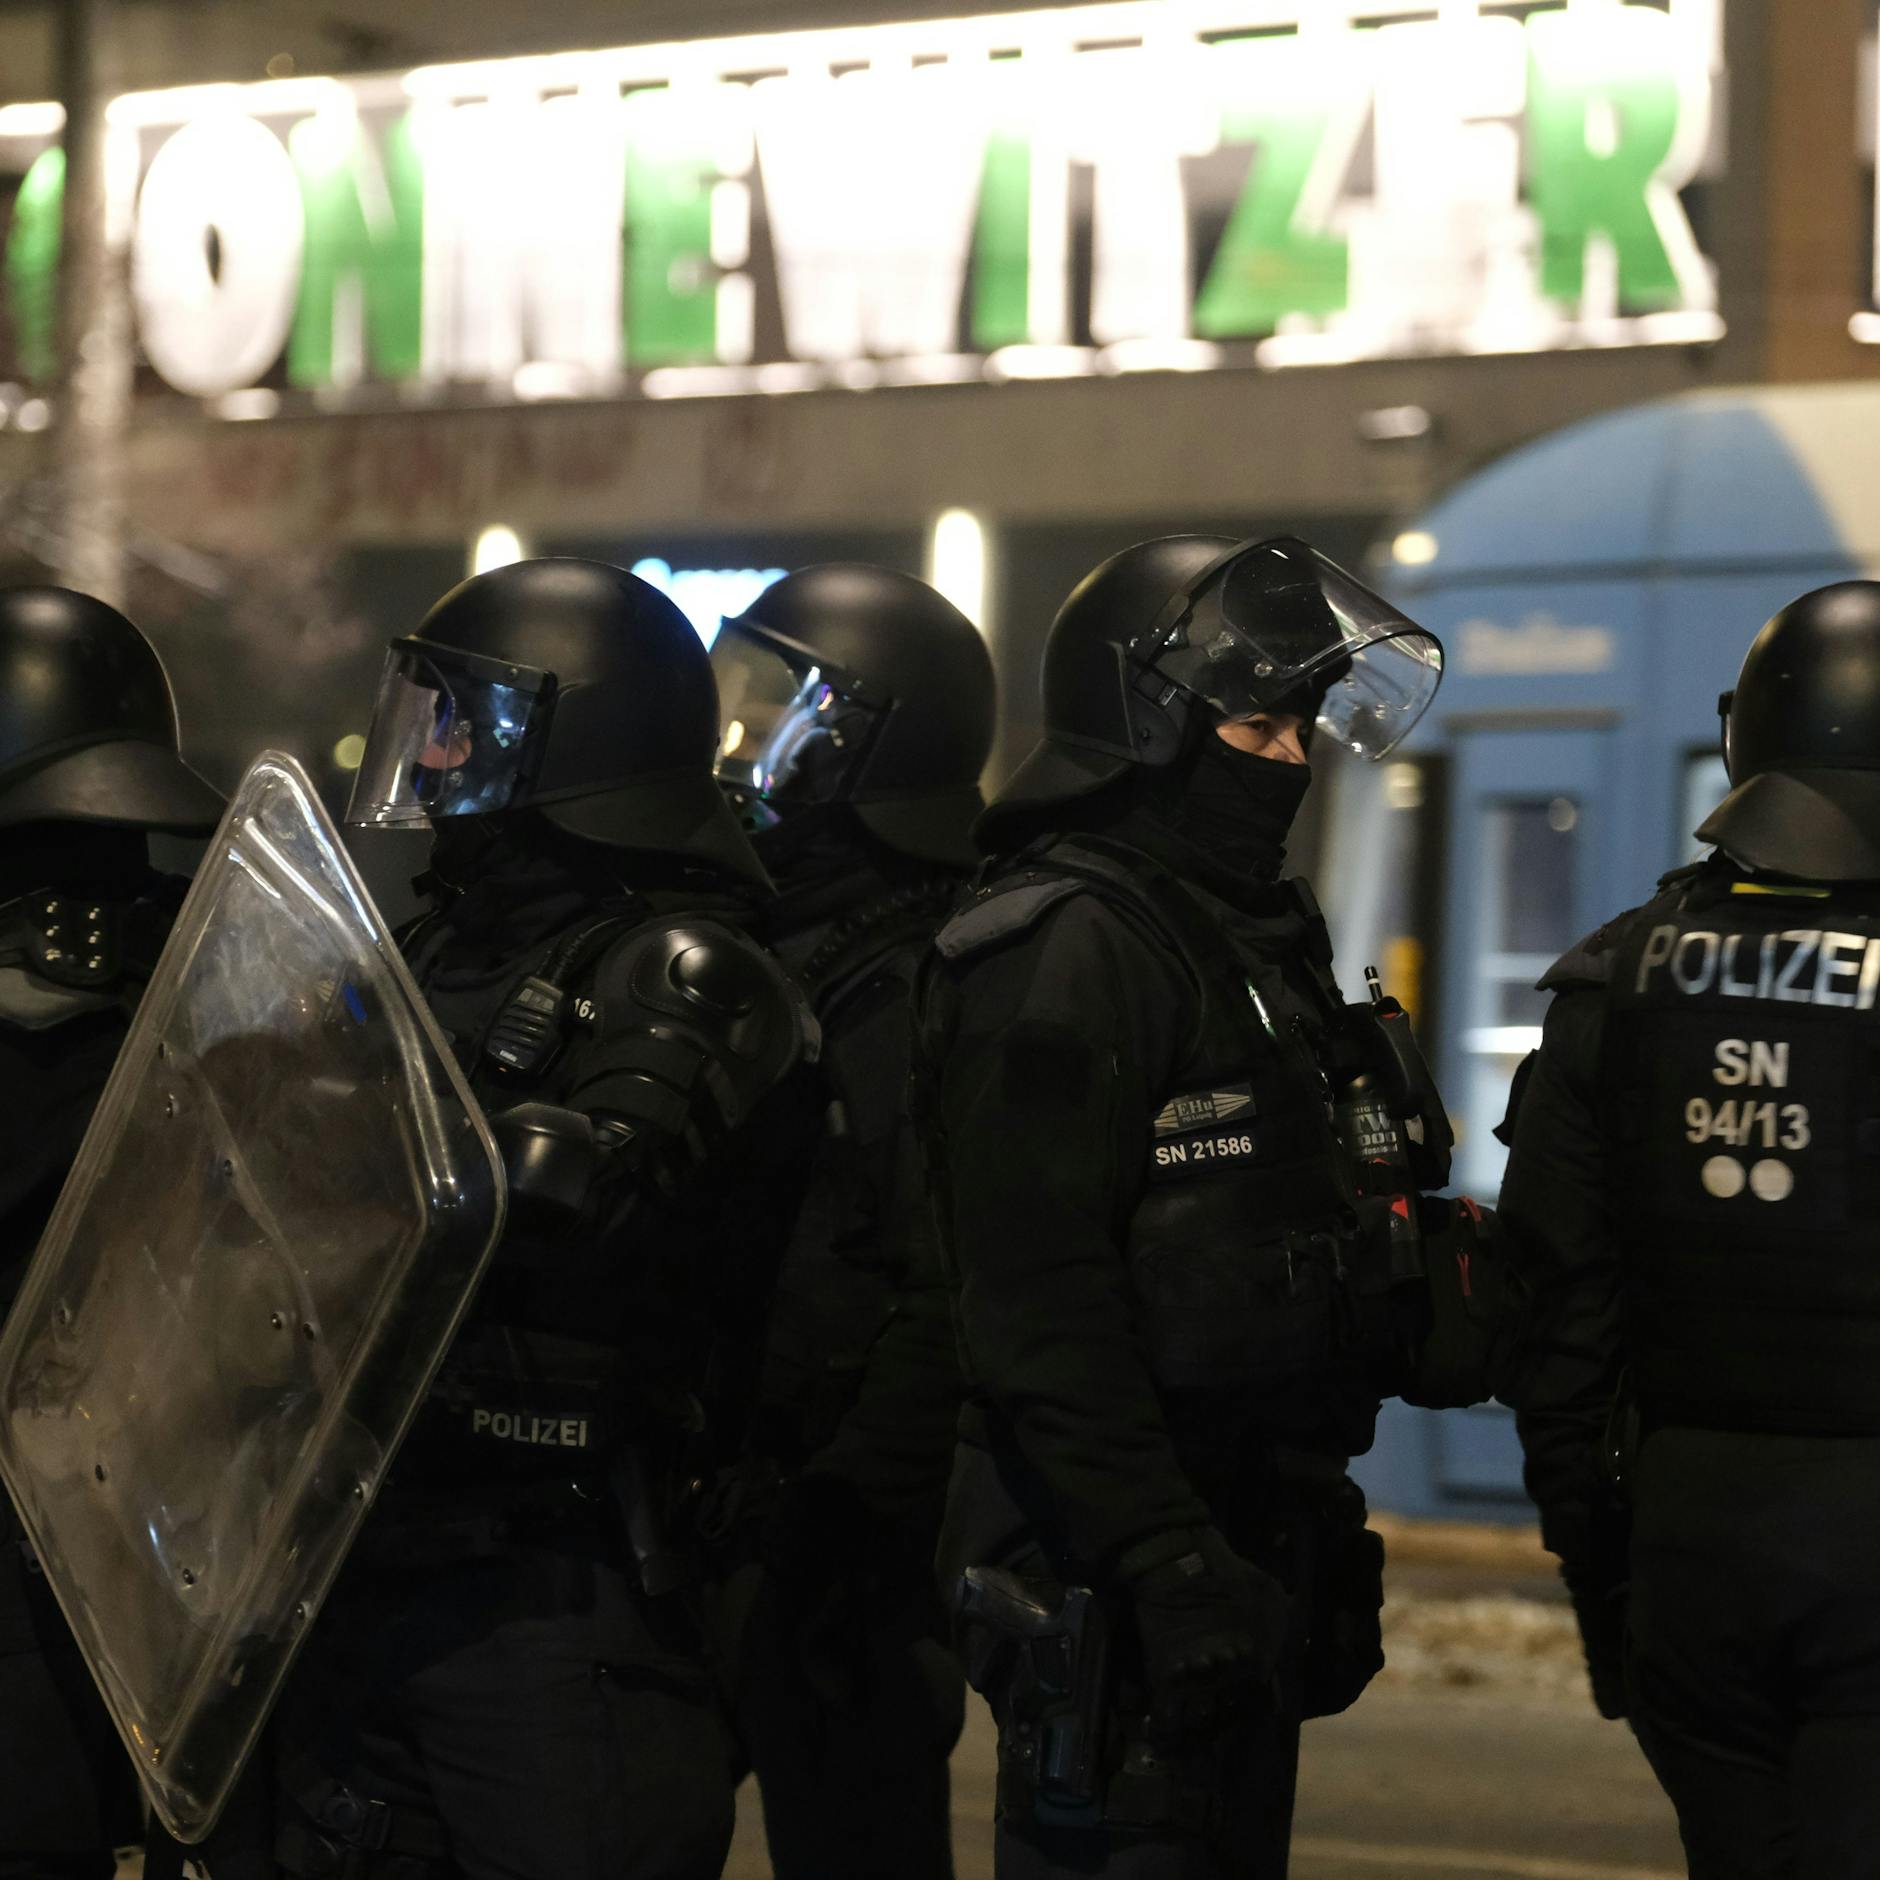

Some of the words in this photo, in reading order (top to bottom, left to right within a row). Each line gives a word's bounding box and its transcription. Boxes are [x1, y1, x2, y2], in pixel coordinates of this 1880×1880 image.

[1634, 924, 1880, 1010] POLIZEI
[1711, 1038, 1790, 1088] SN
[1684, 1097, 1812, 1150] 94/13
[1155, 1143, 1187, 1166] SN
[1192, 1135, 1253, 1160] 21586
[472, 1408, 588, 1448] POLIZEI
